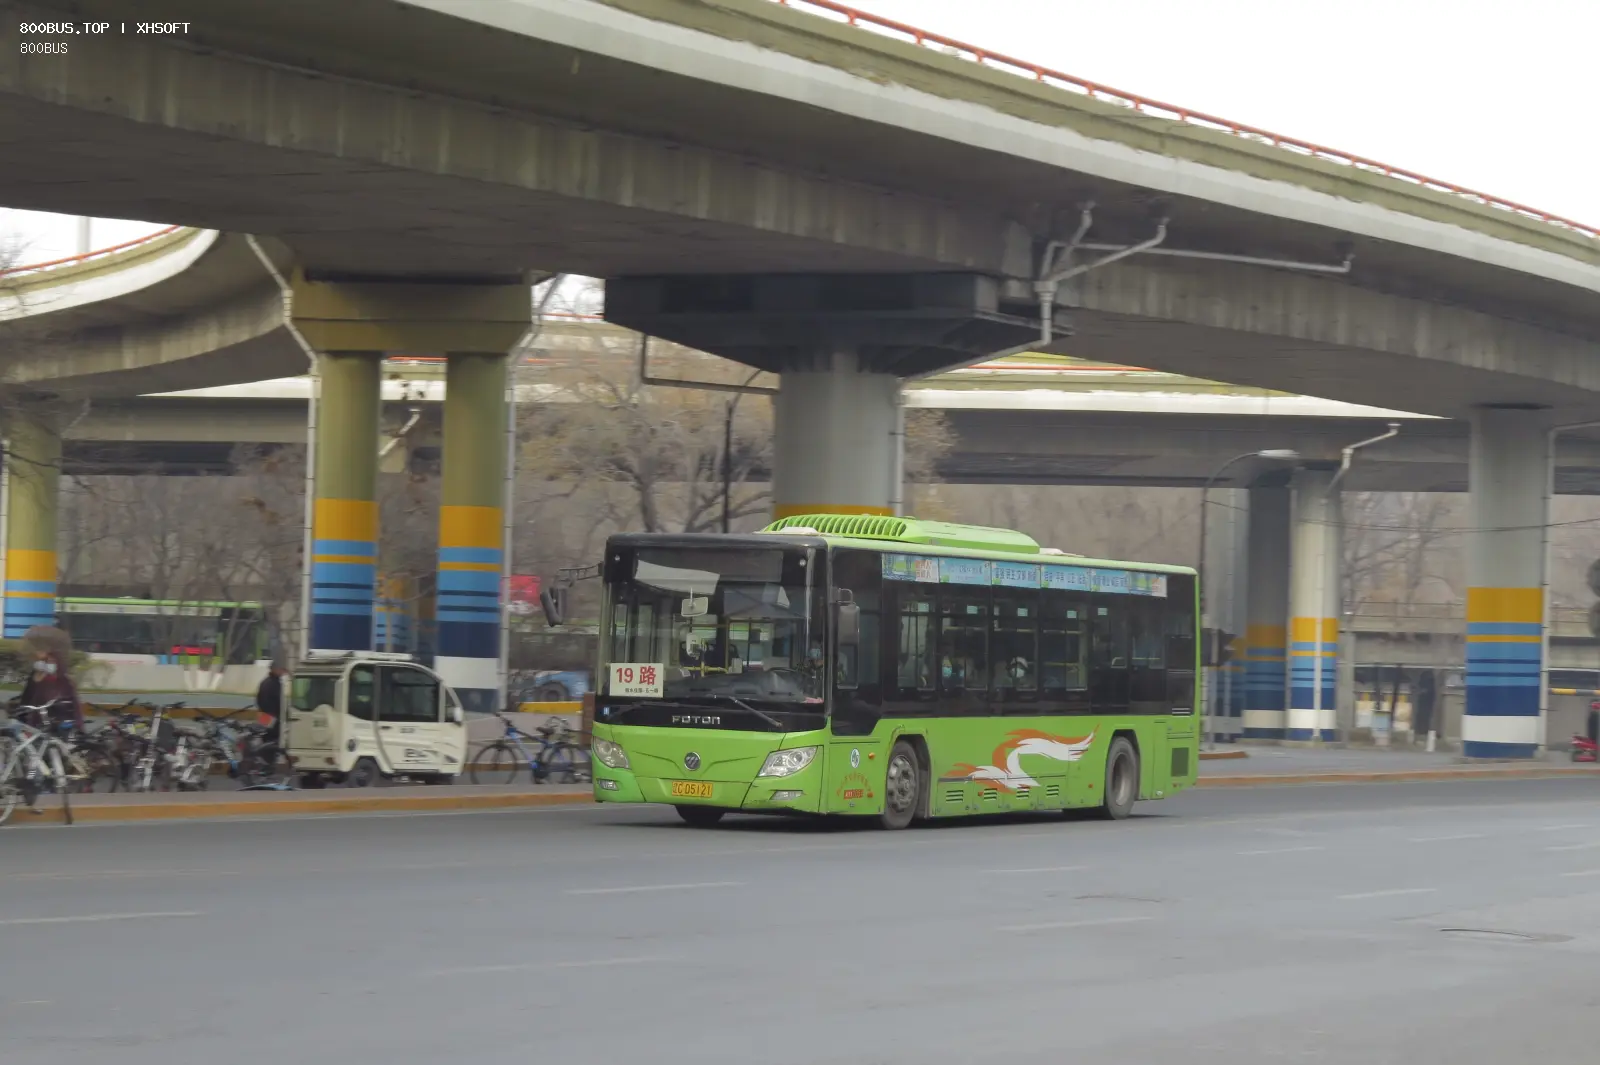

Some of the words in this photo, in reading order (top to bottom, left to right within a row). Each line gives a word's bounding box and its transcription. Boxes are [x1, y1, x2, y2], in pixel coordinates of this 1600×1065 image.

[616, 667, 634, 684] 19
[639, 665, 656, 685] 路
[672, 715, 721, 725] FOTON
